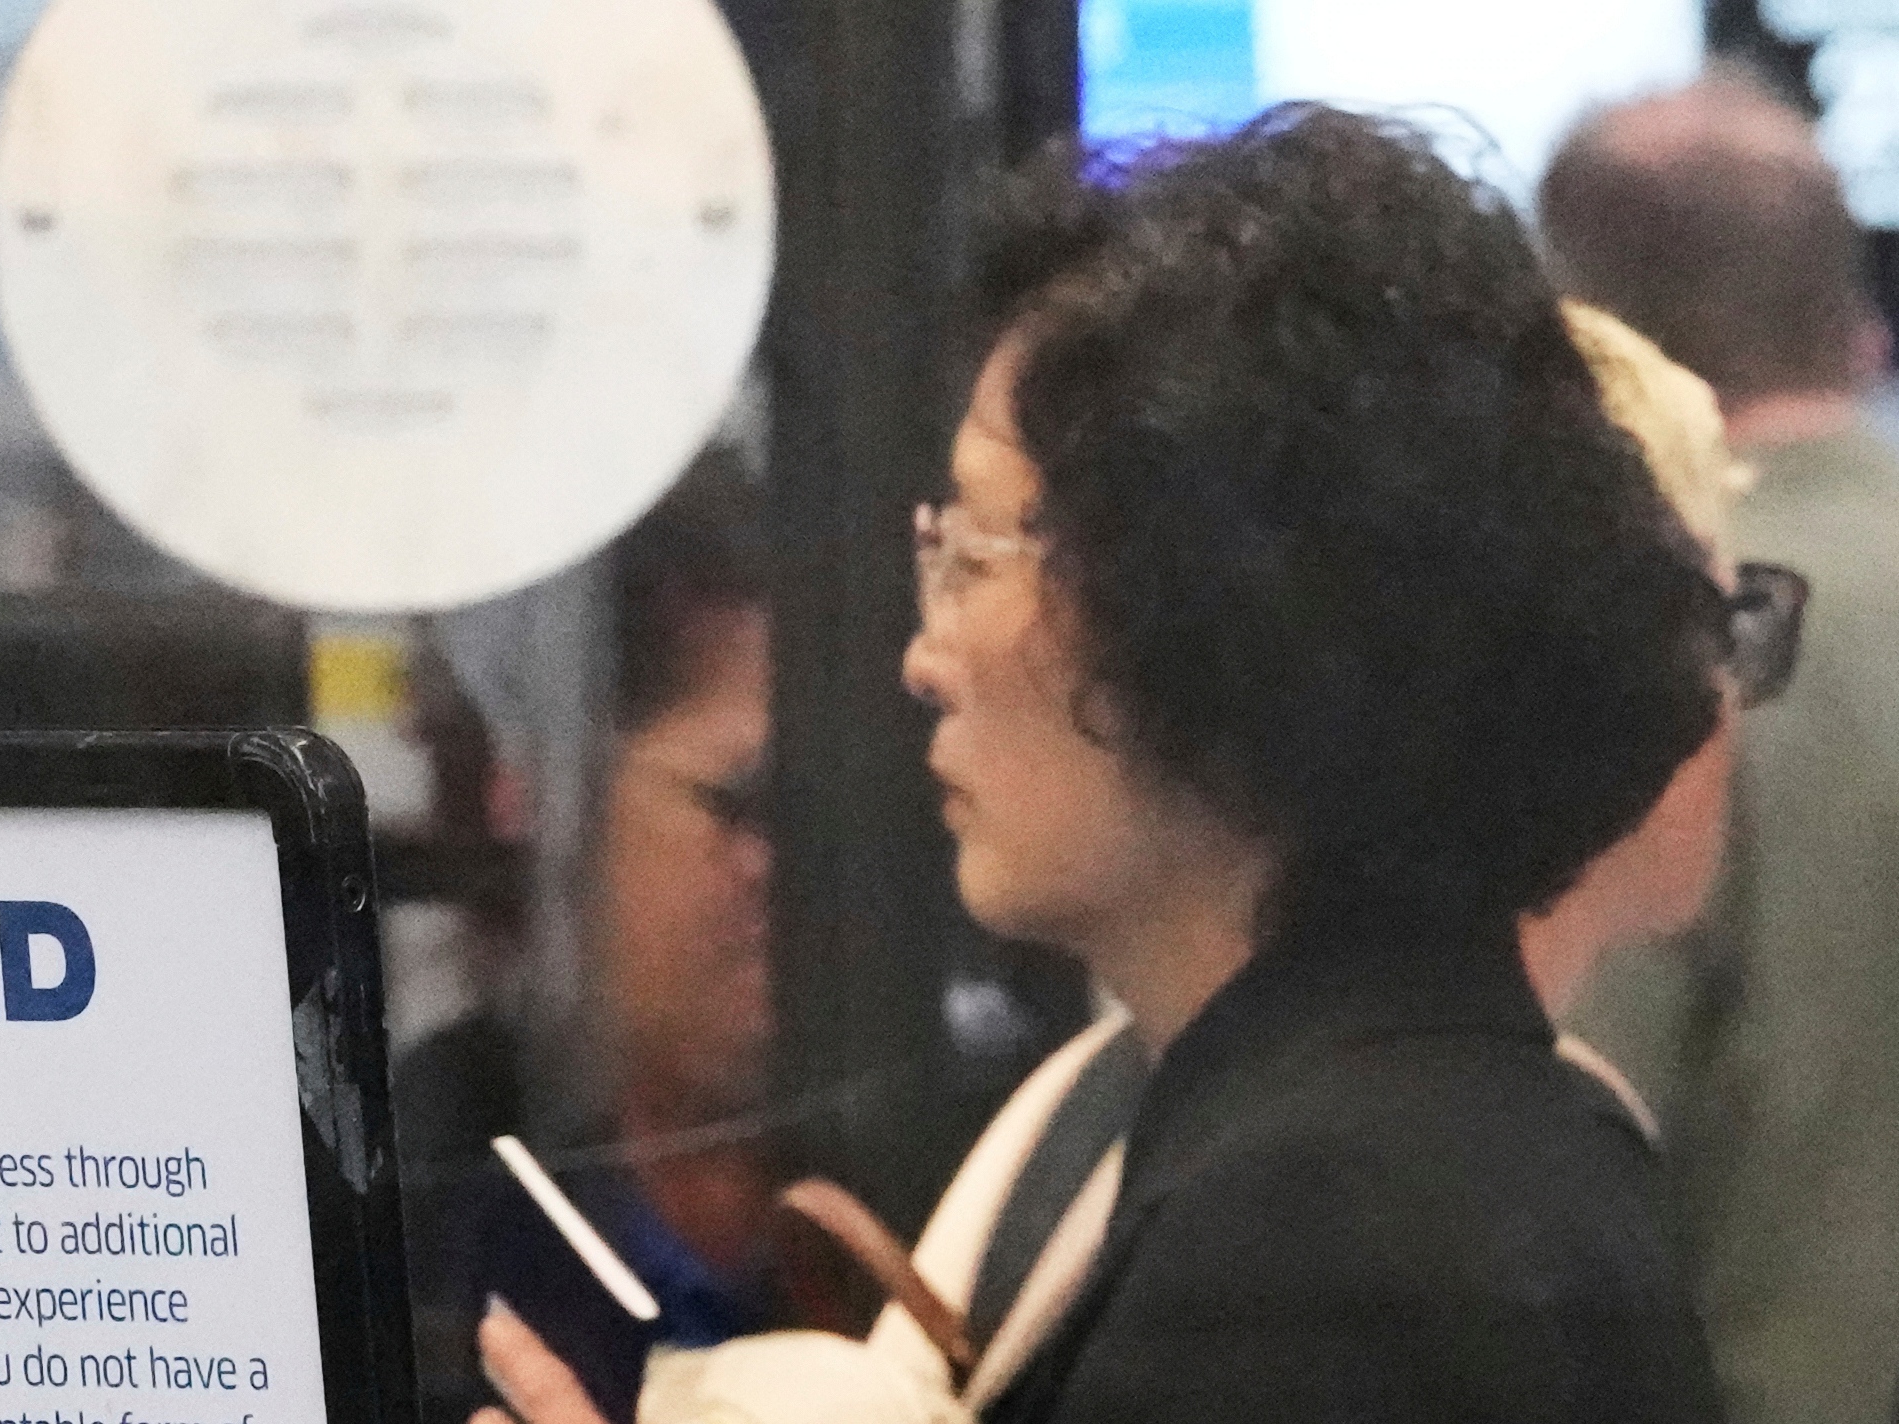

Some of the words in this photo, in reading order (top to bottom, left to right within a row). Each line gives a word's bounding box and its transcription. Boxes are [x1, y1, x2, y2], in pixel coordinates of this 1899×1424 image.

[64, 1145, 206, 1197] through
[12, 1213, 48, 1254] to
[61, 1212, 238, 1257] additional
[23, 1344, 68, 1387] do
[80, 1348, 138, 1388] not
[149, 1346, 236, 1390] have
[250, 1358, 268, 1390] a
